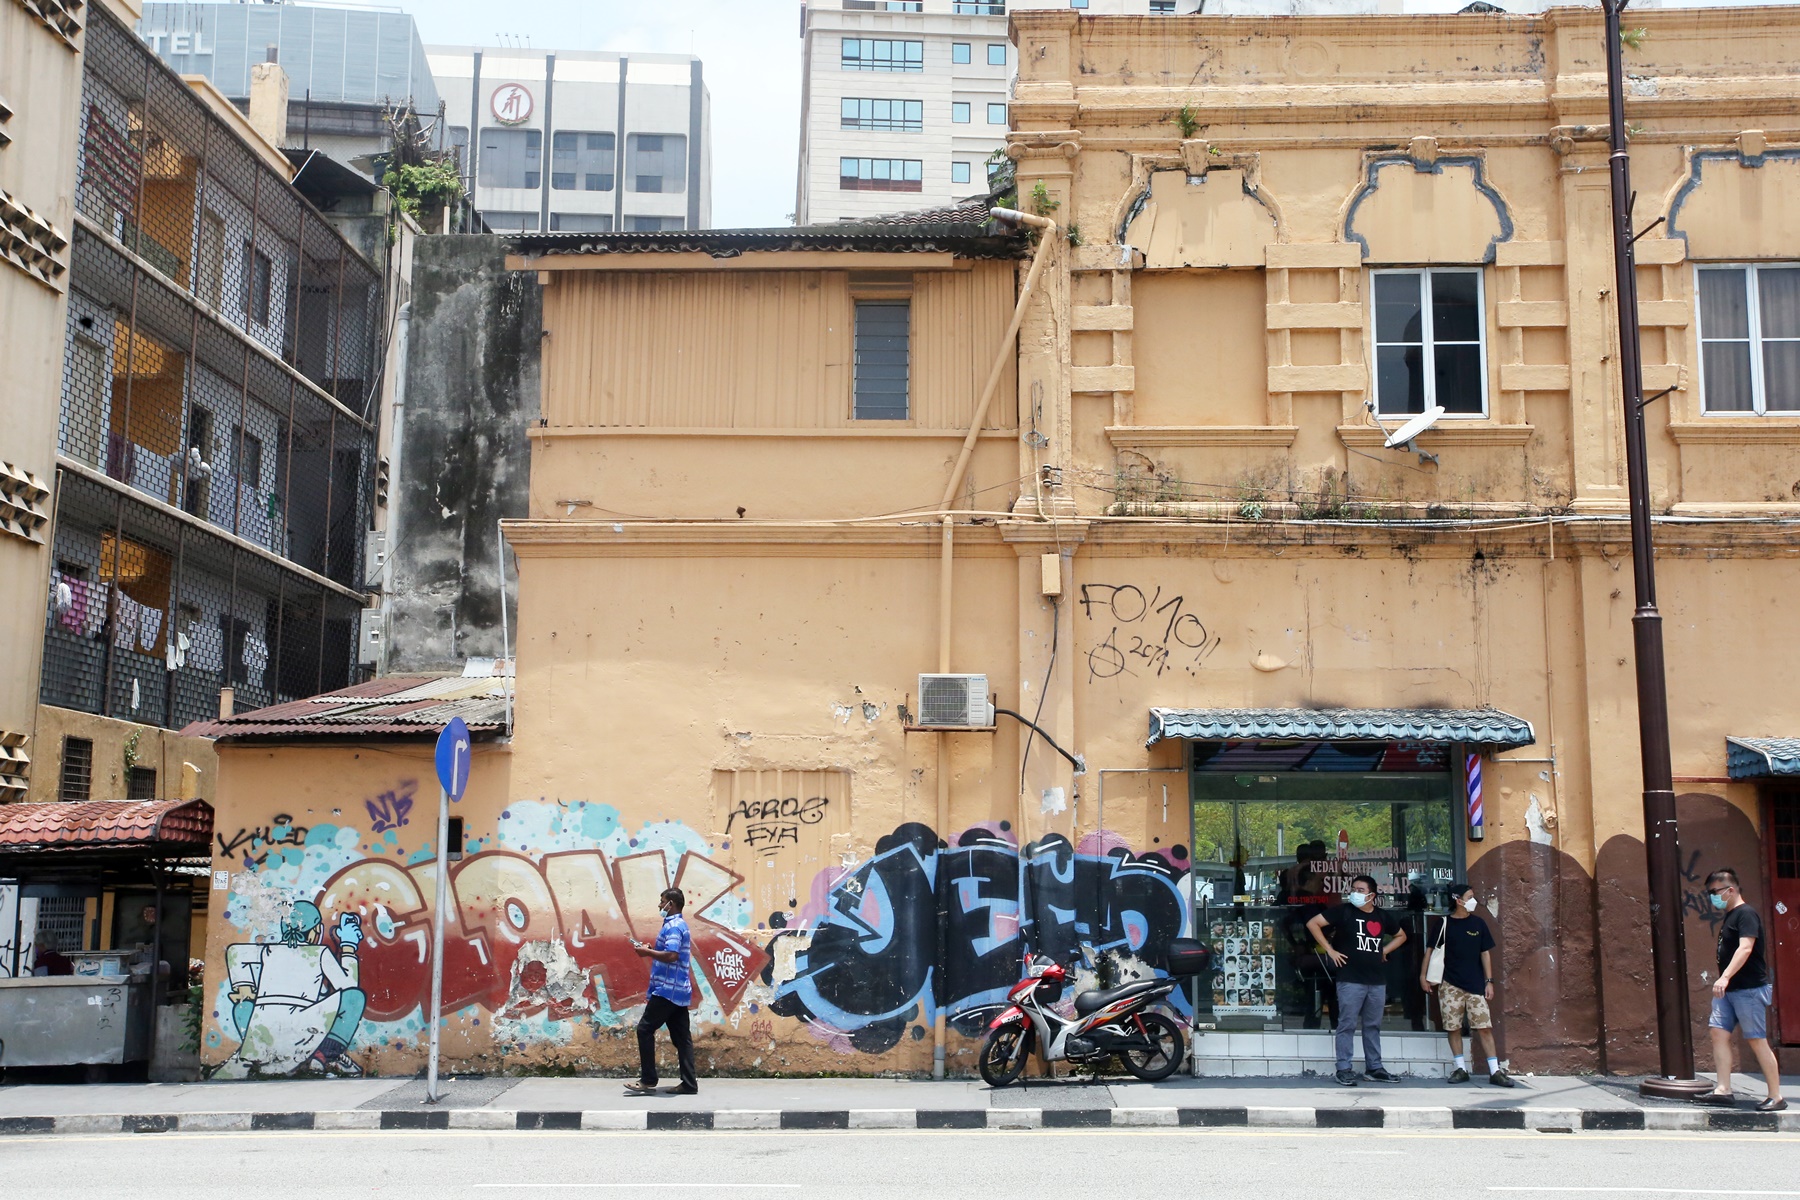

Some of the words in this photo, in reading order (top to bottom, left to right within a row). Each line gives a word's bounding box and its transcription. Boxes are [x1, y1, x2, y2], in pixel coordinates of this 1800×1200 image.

[141, 31, 213, 55] TEL
[1310, 860, 1338, 873] KEDAI
[1355, 918, 1366, 936] I
[1356, 935, 1382, 953] MY
